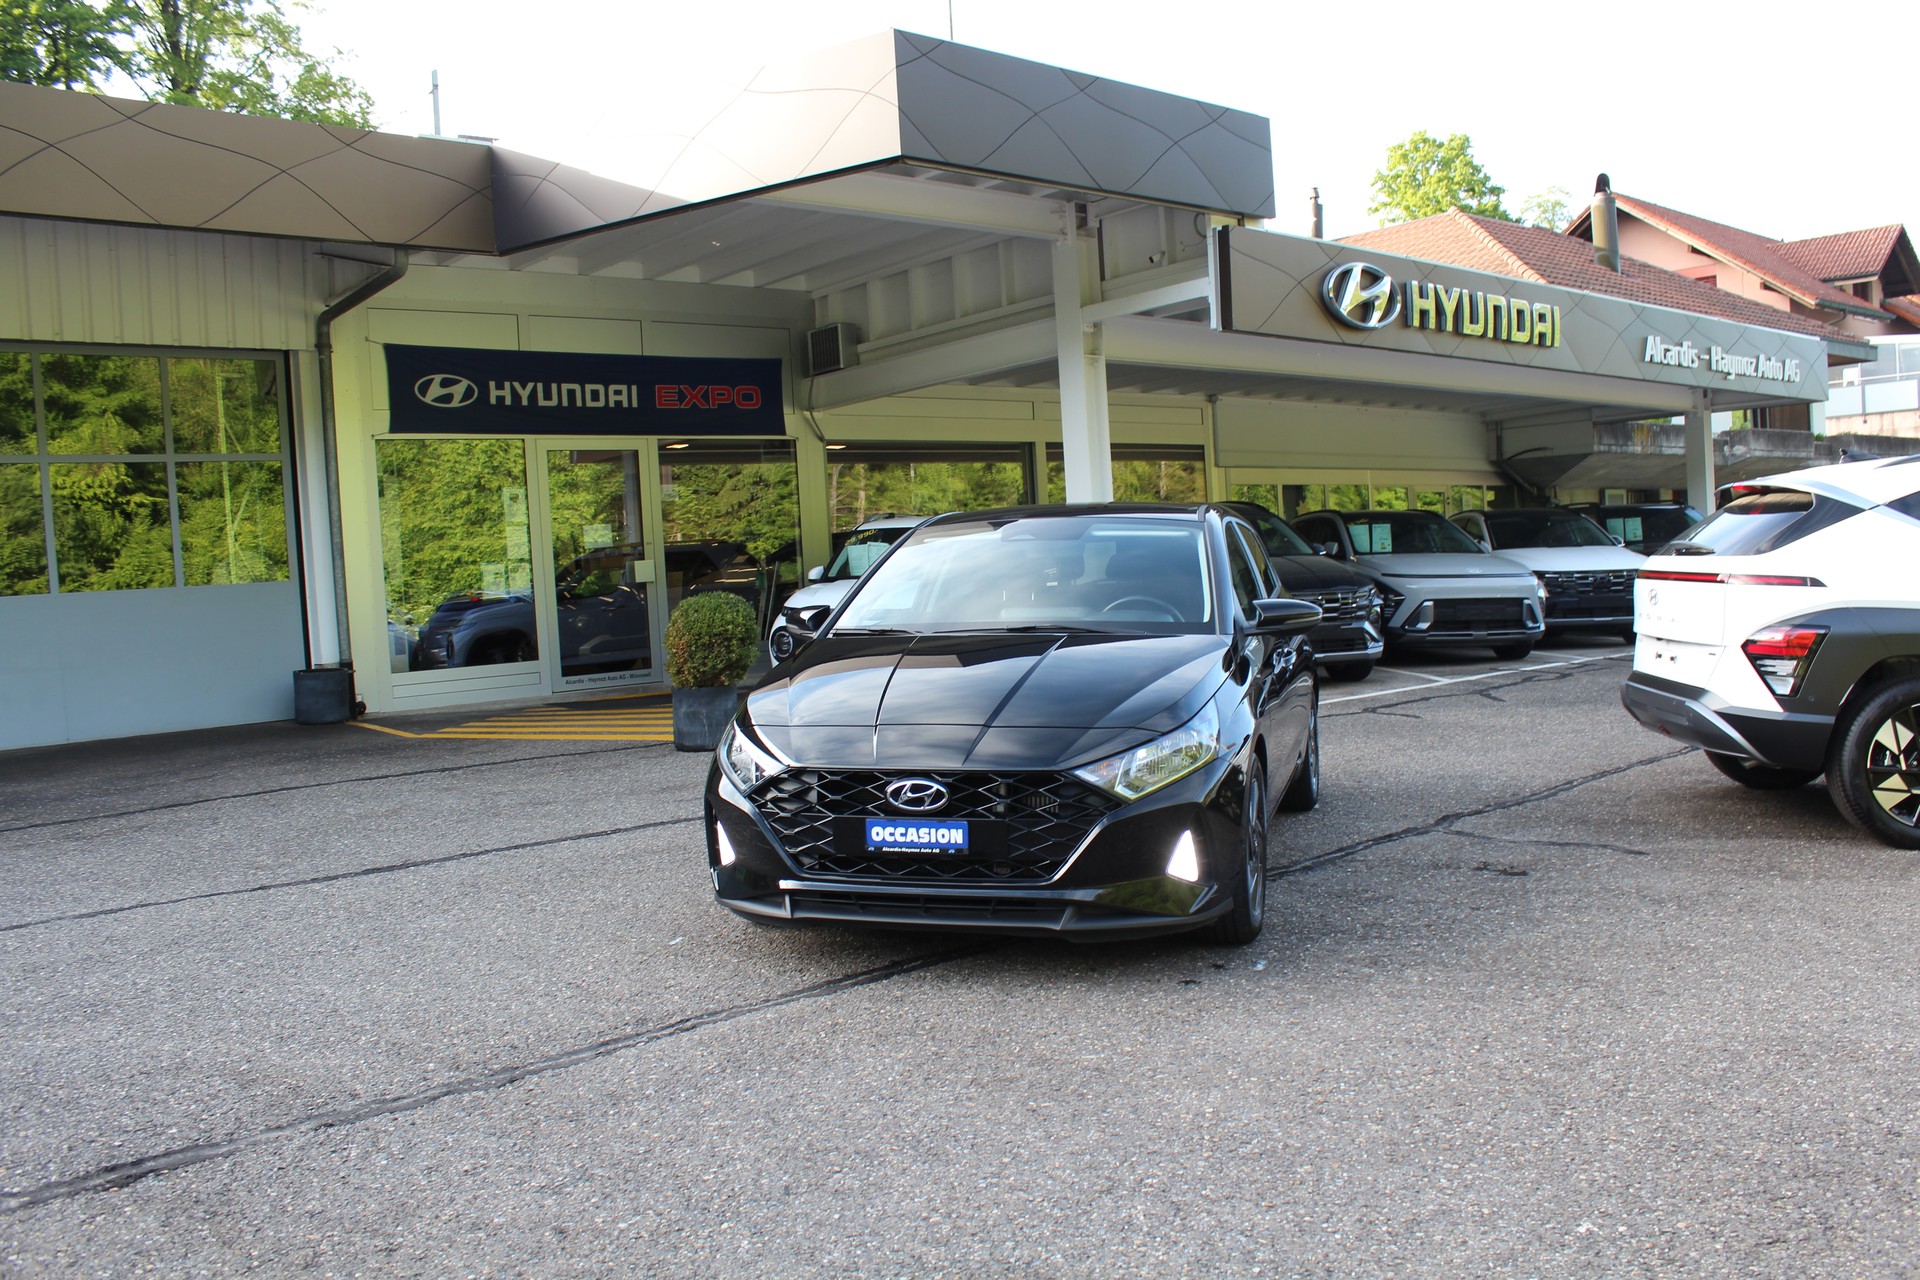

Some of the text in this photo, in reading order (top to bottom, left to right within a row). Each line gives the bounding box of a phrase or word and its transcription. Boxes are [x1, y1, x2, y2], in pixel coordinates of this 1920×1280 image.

[1408, 280, 1561, 348] HYUNDAI
[1644, 335, 1698, 368] Alcardis
[1710, 345, 1756, 380] Haymoz
[1757, 353, 1783, 380] Auto
[1784, 358, 1800, 382] AG
[489, 381, 761, 409] HYUNDAI EXPO
[871, 826, 964, 844] OCCASION
